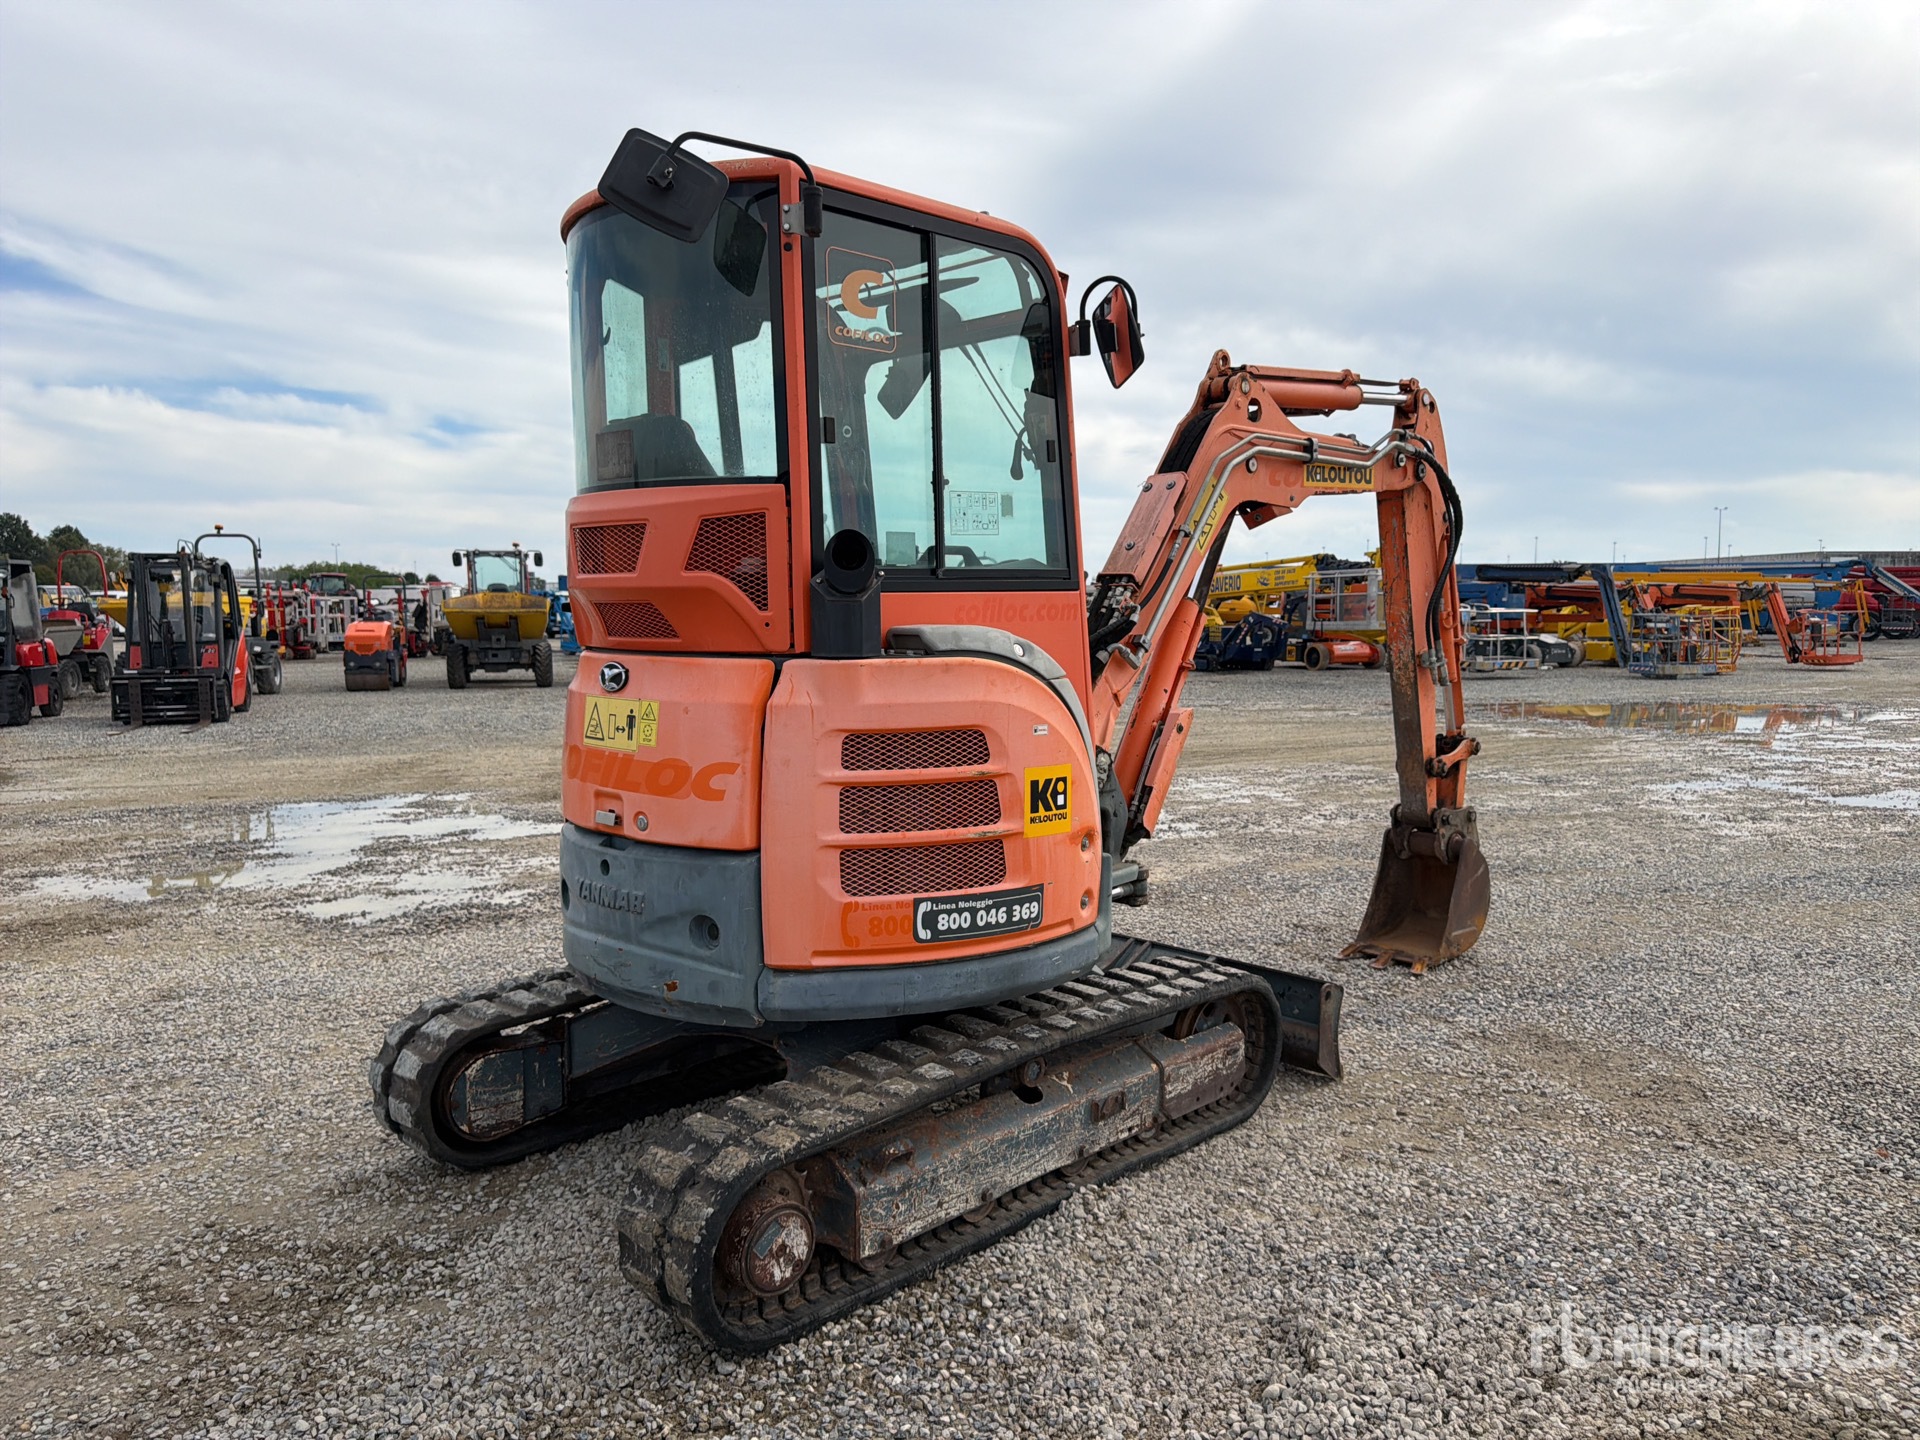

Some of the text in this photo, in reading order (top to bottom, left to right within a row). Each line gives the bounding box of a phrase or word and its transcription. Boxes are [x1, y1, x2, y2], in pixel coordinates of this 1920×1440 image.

[835, 325, 890, 345] COFILOC
[953, 597, 1079, 624] cofiloc.com
[861, 903, 892, 911] Linea
[932, 899, 993, 911] Linea Noleggio
[868, 914, 913, 937] 800
[937, 901, 1039, 931] 800 046 369
